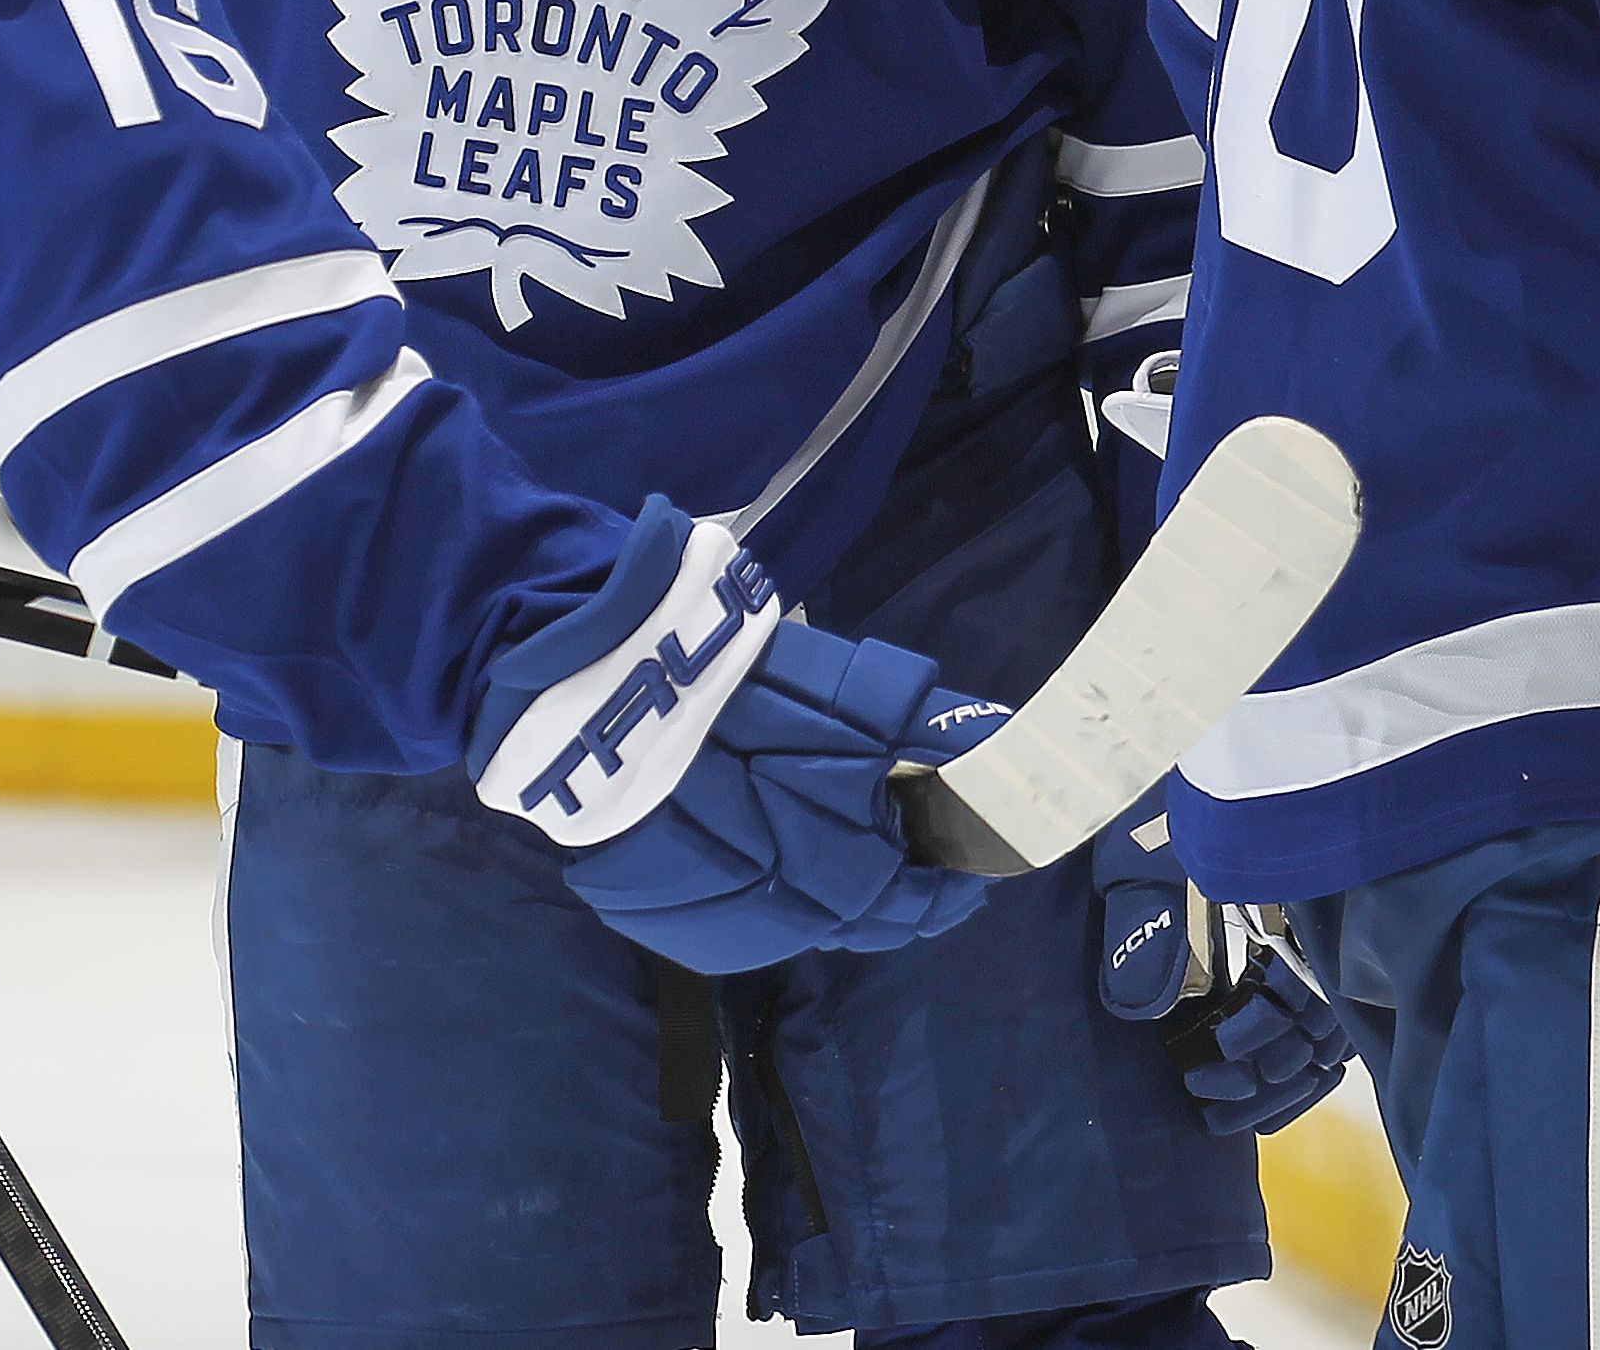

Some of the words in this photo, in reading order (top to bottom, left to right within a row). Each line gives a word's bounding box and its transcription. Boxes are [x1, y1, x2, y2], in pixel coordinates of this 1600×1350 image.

[426, 65, 656, 154] MAPLE
[413, 132, 643, 220] LEAFS
[518, 547, 775, 818] TRUE
[1112, 908, 1173, 970] CCM
[1403, 1280, 1442, 1327] NHL
